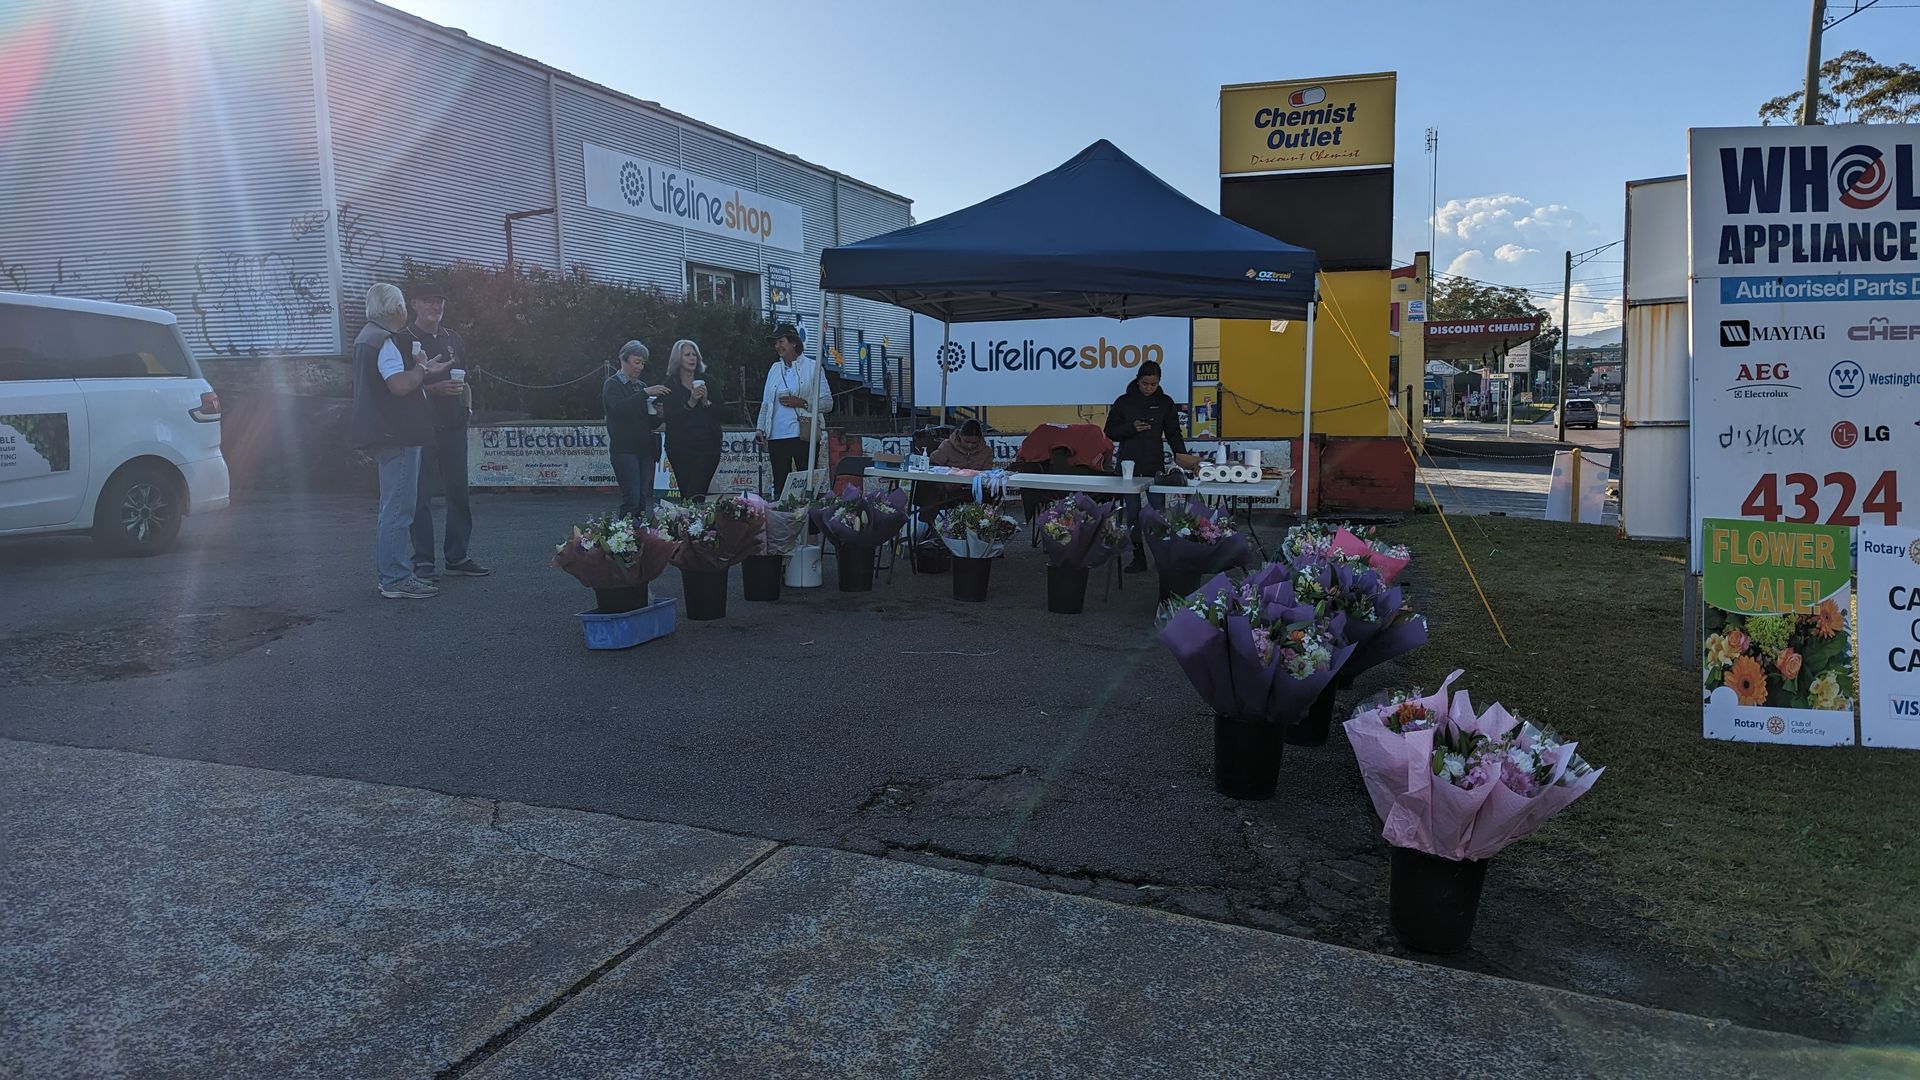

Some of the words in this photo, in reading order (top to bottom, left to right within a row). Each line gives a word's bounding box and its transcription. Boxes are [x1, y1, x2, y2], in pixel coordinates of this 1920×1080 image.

[1254, 103, 1357, 129] Chemist
[1267, 127, 1342, 150] Outlet
[1250, 153, 1305, 166] Discount
[1309, 149, 1360, 162] Chemist
[1718, 221, 1918, 265] APPLIANCE
[1736, 279, 1849, 299] Authorised
[1853, 277, 1908, 297] Parts
[1430, 325, 1485, 335] DISCOUNT
[1488, 322, 1536, 333] CHEMIST
[1752, 325, 1826, 342] MAYTAG
[1196, 364, 1217, 374] LIVE
[1735, 362, 1790, 382] AEG
[1744, 389, 1789, 399] Electrolux
[505, 429, 607, 449] Electrolux
[1864, 425, 1890, 442] LG
[538, 470, 558, 478] AEG
[1741, 470, 1902, 527] 4324
[1712, 528, 1837, 569] FLOWER
[1864, 540, 1906, 558] Rotary
[1736, 576, 1821, 615] SALE!
[1734, 718, 1765, 730] Rotary
[1814, 728, 1826, 736] City
